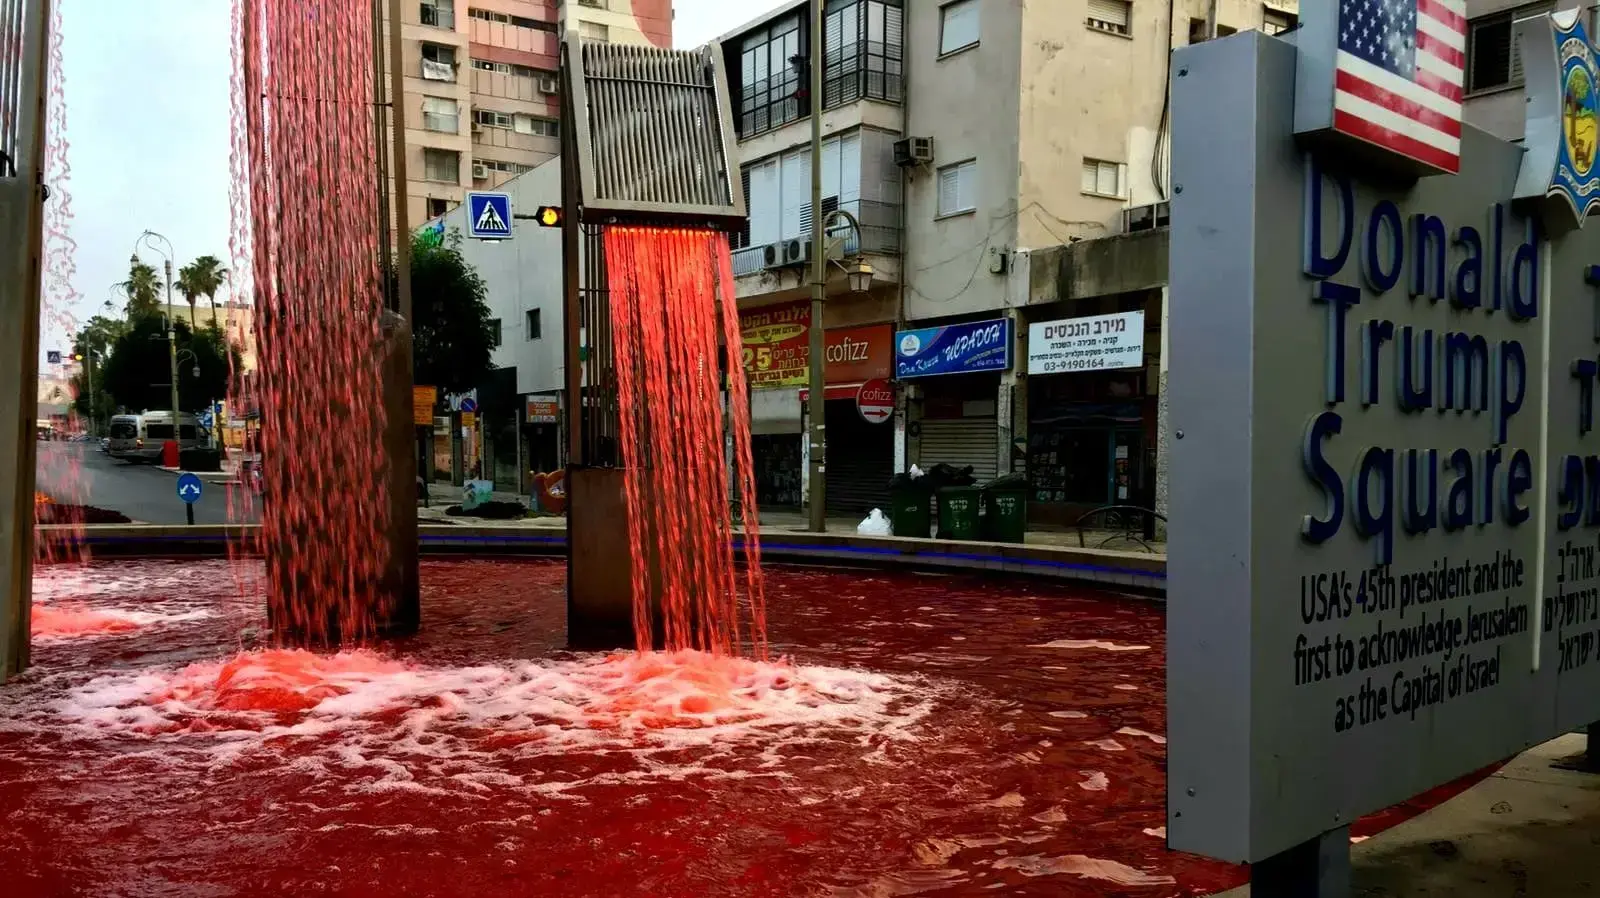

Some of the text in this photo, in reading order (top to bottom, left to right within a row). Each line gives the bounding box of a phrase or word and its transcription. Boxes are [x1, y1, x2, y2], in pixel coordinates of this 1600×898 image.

[1303, 152, 1539, 320] Donald
[740, 312, 770, 328] הקט
[1044, 318, 1126, 340] מירב הנכסים
[743, 347, 772, 371] 25
[826, 336, 869, 362] cofizz
[1050, 341, 1072, 349] השכרה
[1077, 338, 1097, 347] מכירה
[1044, 358, 1105, 371] 03-9190164
[1312, 280, 1527, 448] Trump
[862, 387, 892, 401] cofizz
[1302, 410, 1532, 565] Square
[1301, 549, 1524, 624] USA's 45th president and the
[1545, 584, 1597, 632] בירושלים
[1294, 597, 1528, 686] first to acknowledge Jerusalem
[1558, 629, 1594, 675] ישראל
[1335, 645, 1500, 732] as the Capital of Israel
